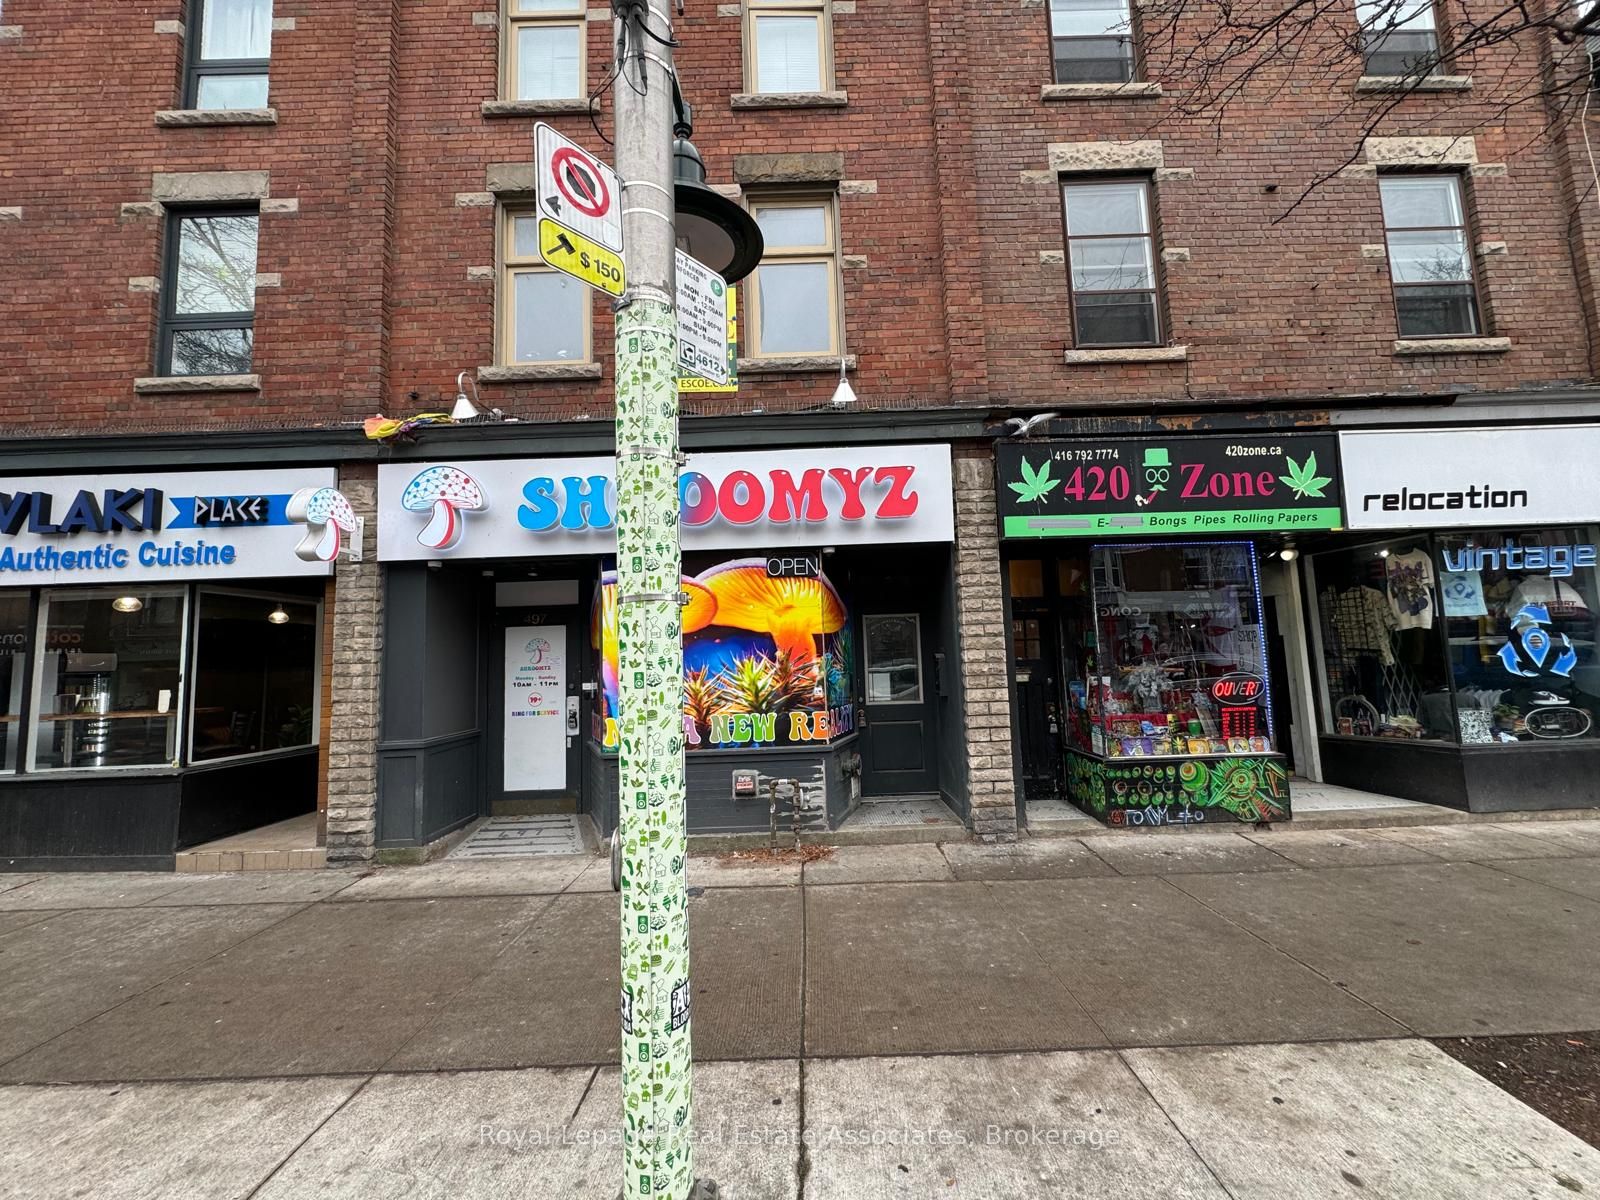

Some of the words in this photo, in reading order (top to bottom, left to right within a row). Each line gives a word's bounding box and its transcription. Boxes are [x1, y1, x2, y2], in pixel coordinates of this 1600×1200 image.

[676, 265, 700, 283] NFORCED
[684, 283, 700, 297] MON
[704, 295, 715, 306] FRI
[694, 305, 706, 317] SAT
[693, 321, 707, 333] SUN
[696, 354, 720, 372] 4612
[1055, 450, 1074, 461] 416
[1075, 449, 1094, 461] 792
[1095, 448, 1119, 460] 7774
[1225, 446, 1282, 457] 420zone.ca
[1063, 465, 1130, 501] 420
[1180, 463, 1276, 498] Zone
[517, 465, 919, 532] SHOOMYZ
[1363, 485, 1528, 512] relocation
[193, 495, 265, 526] PLACE
[1149, 516, 1187, 529] Bongs
[1194, 514, 1226, 527] Pipes
[1232, 513, 1274, 526] Rolling
[1277, 511, 1318, 524] Papers
[0, 543, 129, 572] Authentic
[138, 540, 238, 566] Cuisine
[1442, 537, 1598, 577] vintage
[767, 558, 819, 576] OPEN
[1214, 680, 1262, 698] OUVERT
[709, 712, 778, 743] NEW
